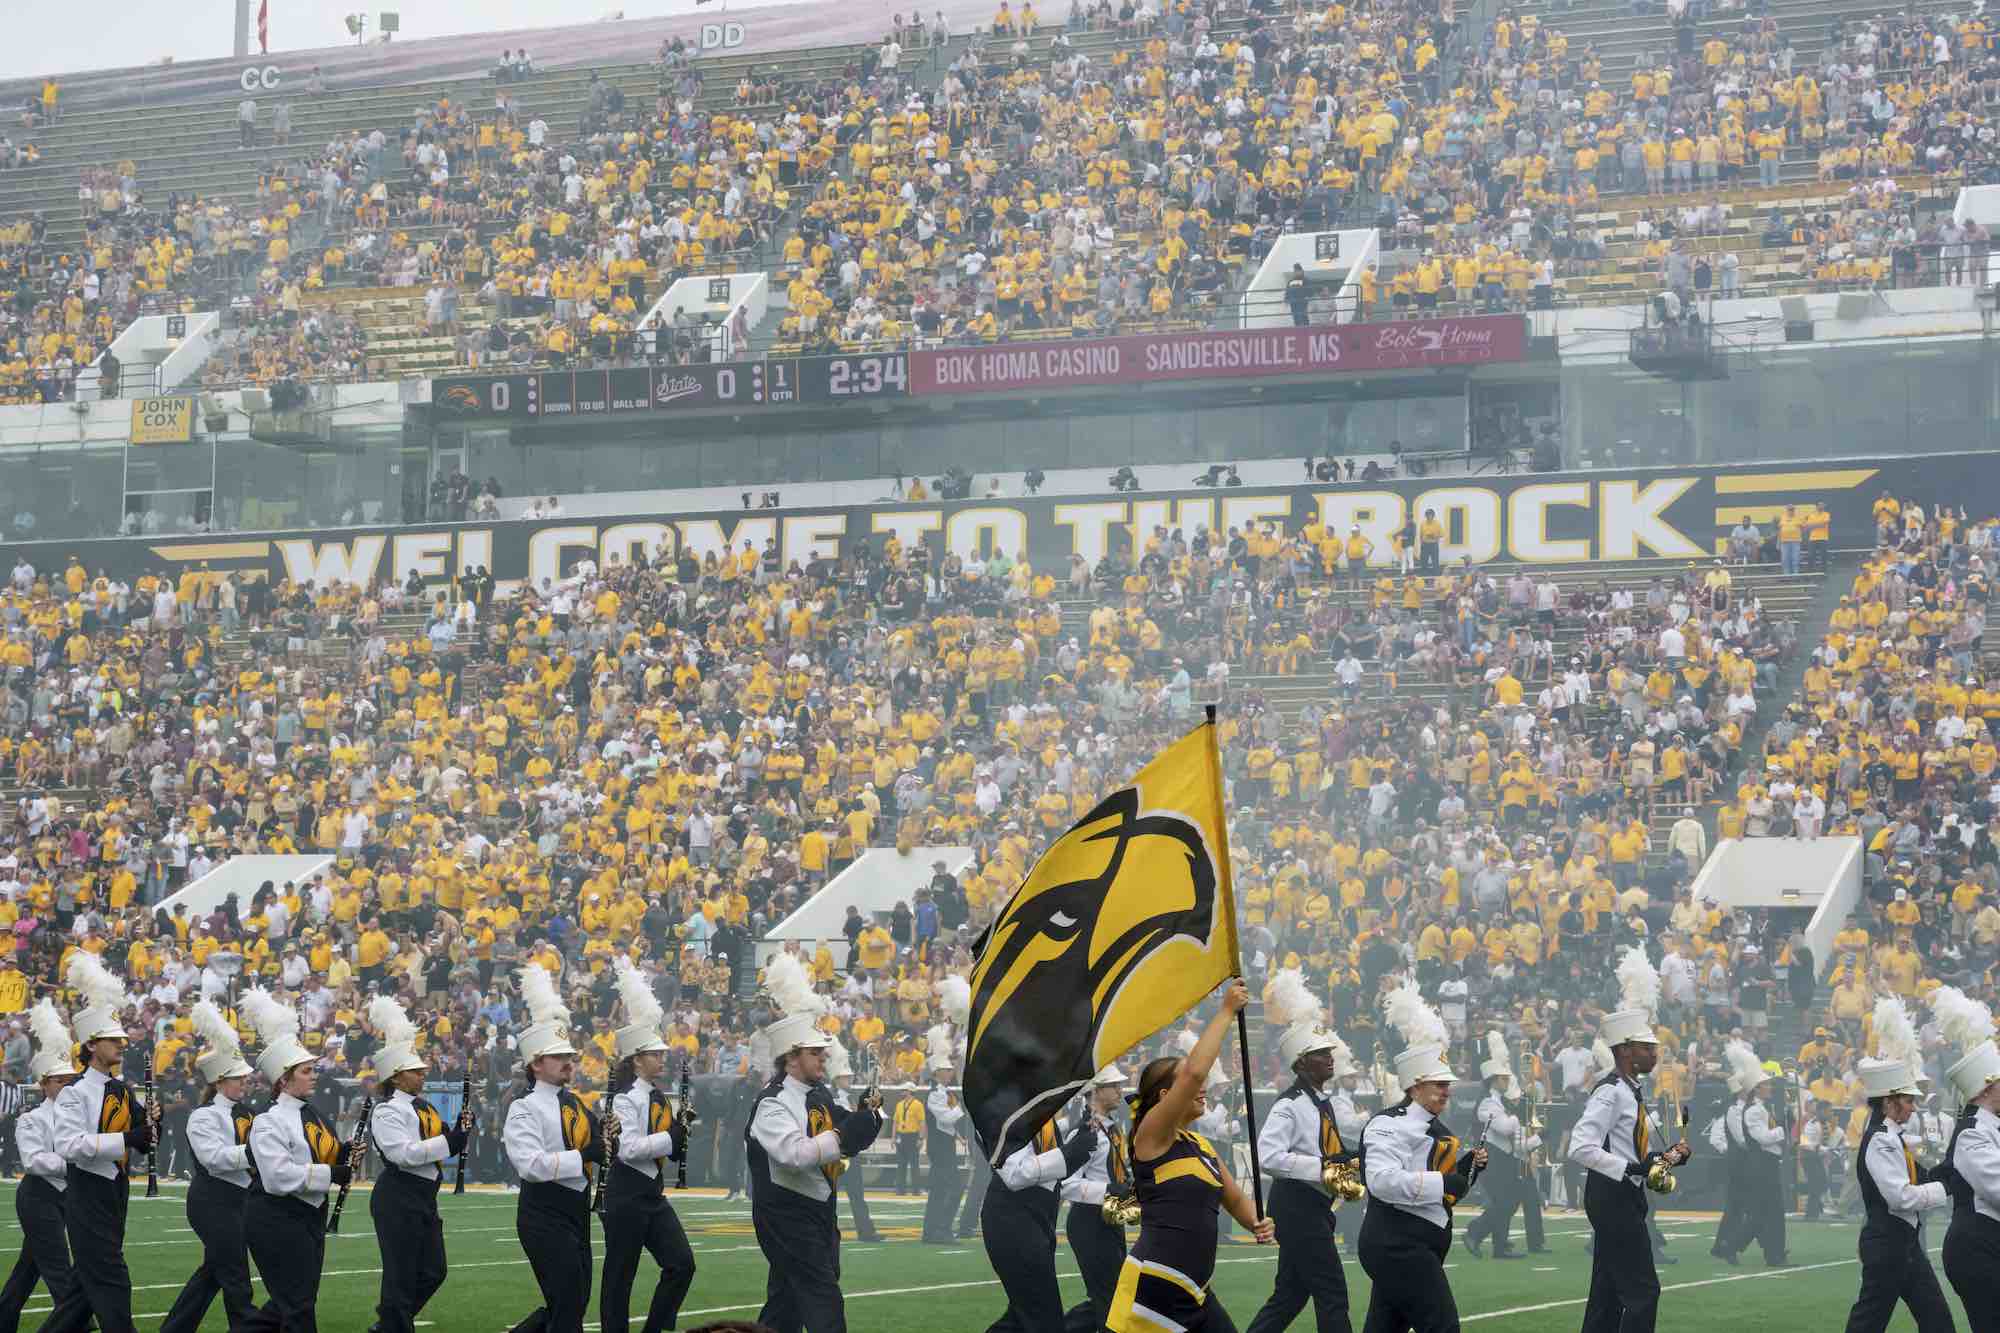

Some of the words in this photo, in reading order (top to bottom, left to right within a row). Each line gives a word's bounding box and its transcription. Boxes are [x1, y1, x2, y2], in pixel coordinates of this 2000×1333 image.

[702, 23, 744, 48] DD
[241, 66, 280, 90] CC
[935, 356, 976, 385] BOK
[981, 352, 1041, 381] HOMA
[1046, 345, 1120, 377] CASINO
[1145, 335, 1303, 371] SANDERSVILLE,
[1309, 333, 1340, 362] MS
[655, 373, 702, 401] State
[716, 369, 736, 399] 0
[774, 364, 787, 387] 1
[829, 356, 906, 394] 2:34
[137, 400, 185, 413] JOHN
[491, 381, 510, 412] 0
[143, 415, 177, 426] COX
[1312, 477, 1714, 569] ROCK
